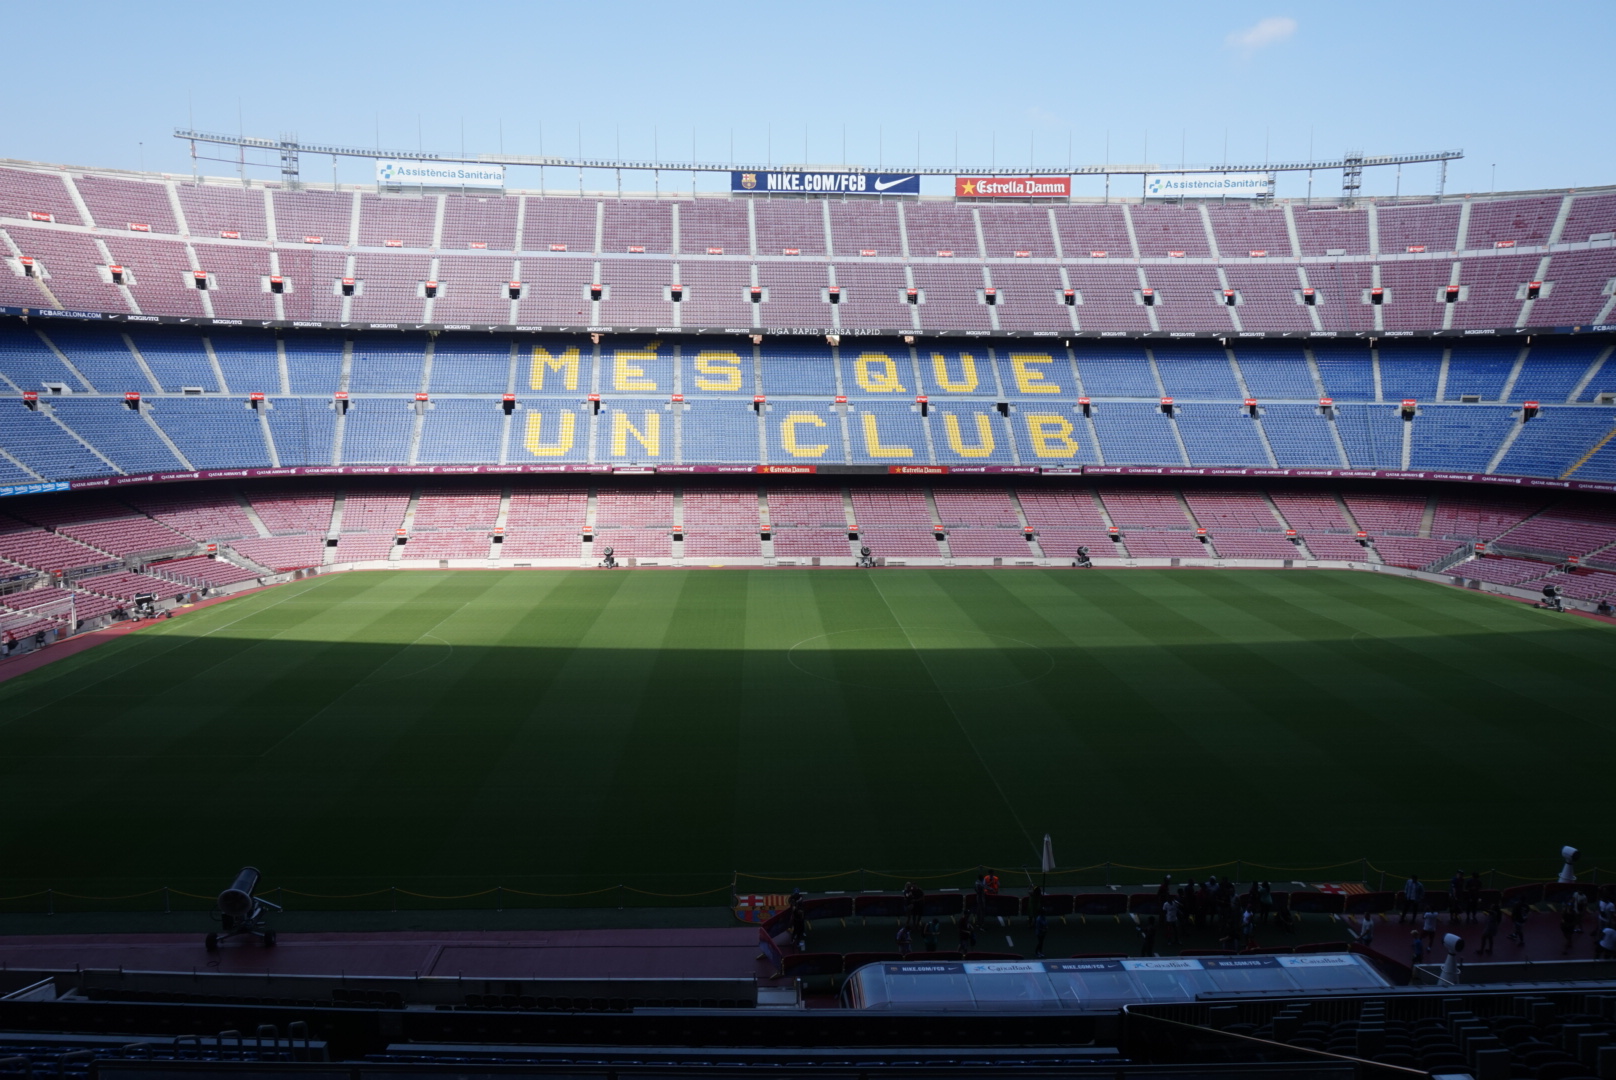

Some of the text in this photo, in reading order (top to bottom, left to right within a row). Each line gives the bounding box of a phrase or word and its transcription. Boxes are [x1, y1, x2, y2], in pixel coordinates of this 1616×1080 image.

[397, 166, 502, 180] Assistència Sanitària
[767, 174, 866, 191] NIKE.COM/FCB
[976, 180, 1066, 194] Estrella Damm
[1165, 178, 1268, 188] Assistència Sanitària
[39, 310, 102, 319] FCBARCELONA.COM
[528, 340, 1062, 394] MÉS QUE
[523, 409, 1080, 458] UN CLUB
